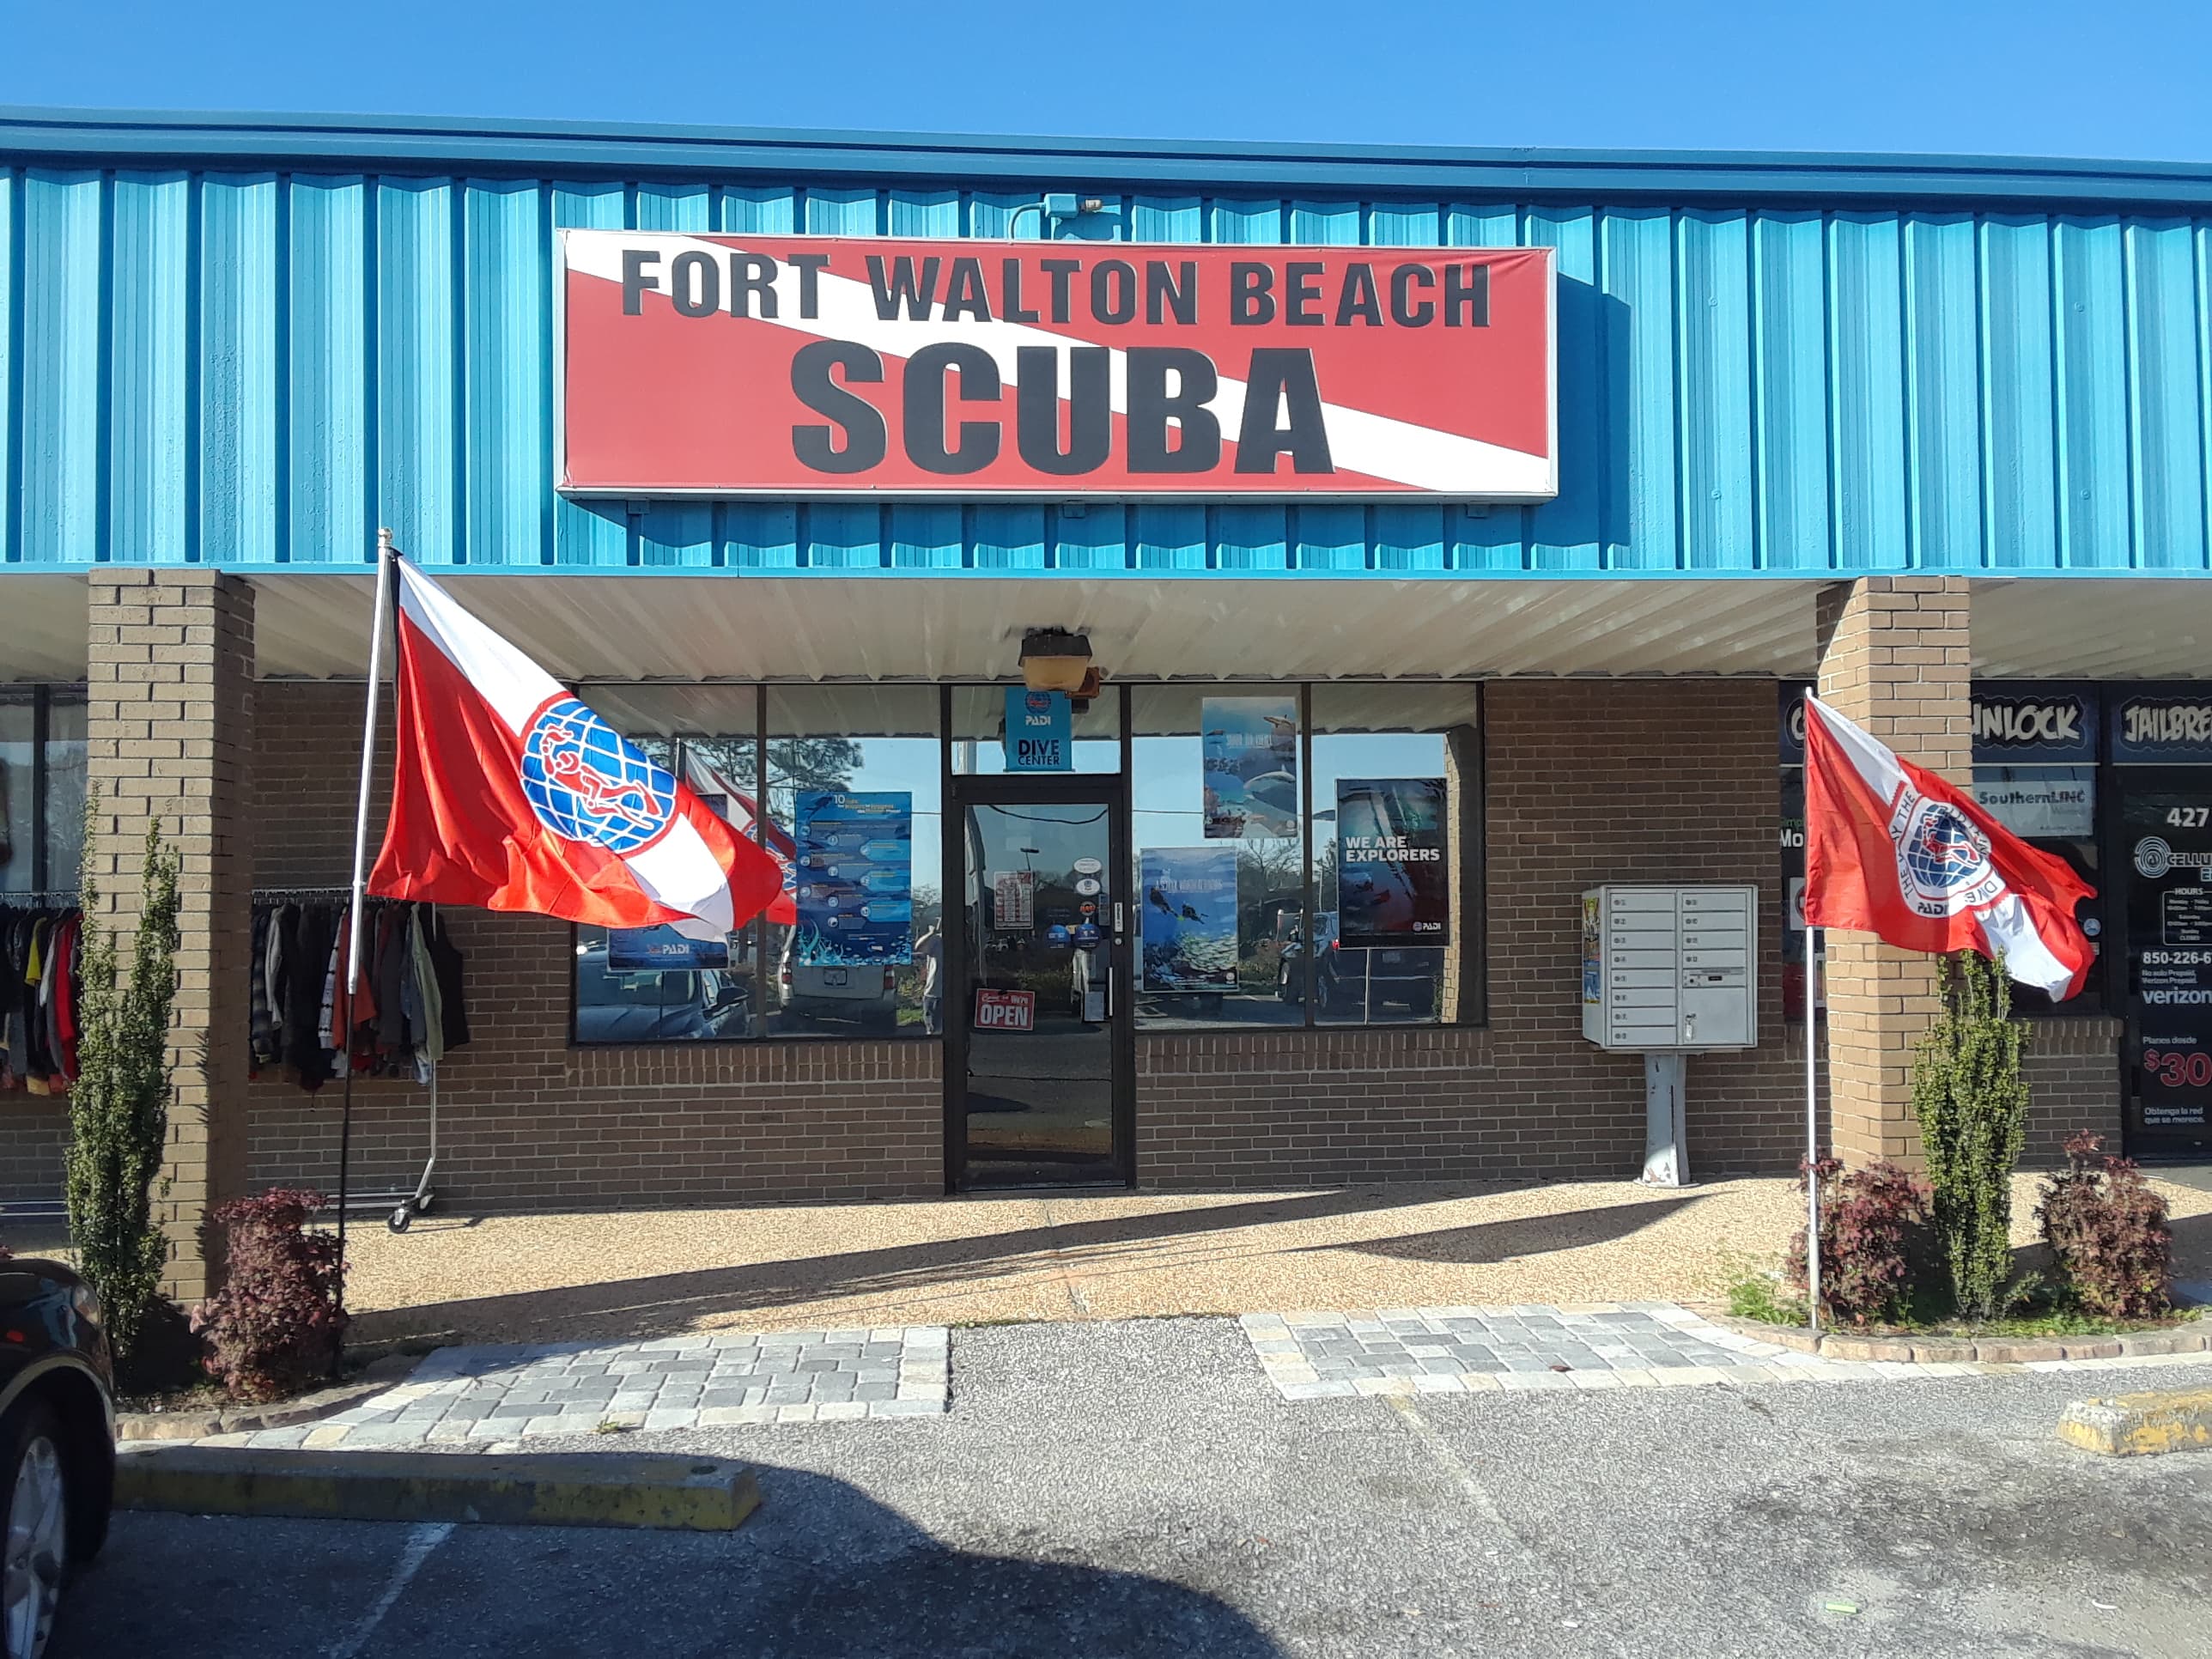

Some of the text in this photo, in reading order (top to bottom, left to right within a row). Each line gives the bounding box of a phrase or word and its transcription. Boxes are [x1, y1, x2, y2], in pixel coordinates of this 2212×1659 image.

[622, 250, 1490, 327] FORT WALTON BEACH
[791, 339, 1335, 476] SCUBA
[1025, 715, 1051, 726] PADI
[2125, 705, 2212, 742] JAILBRE
[1018, 739, 1060, 756] DIVE
[1018, 756, 1060, 765] CENTER
[834, 794, 846, 804] 10
[1898, 791, 1916, 819] THE
[2166, 807, 2210, 827] 427
[1346, 836, 1407, 848] WE ARE
[1346, 848, 1441, 862] EXPLORERS
[662, 944, 690, 955] PADI
[2142, 951, 2212, 964] 850-226-6
[2142, 986, 2212, 1004] verizon
[981, 1004, 1029, 1026] OPEN
